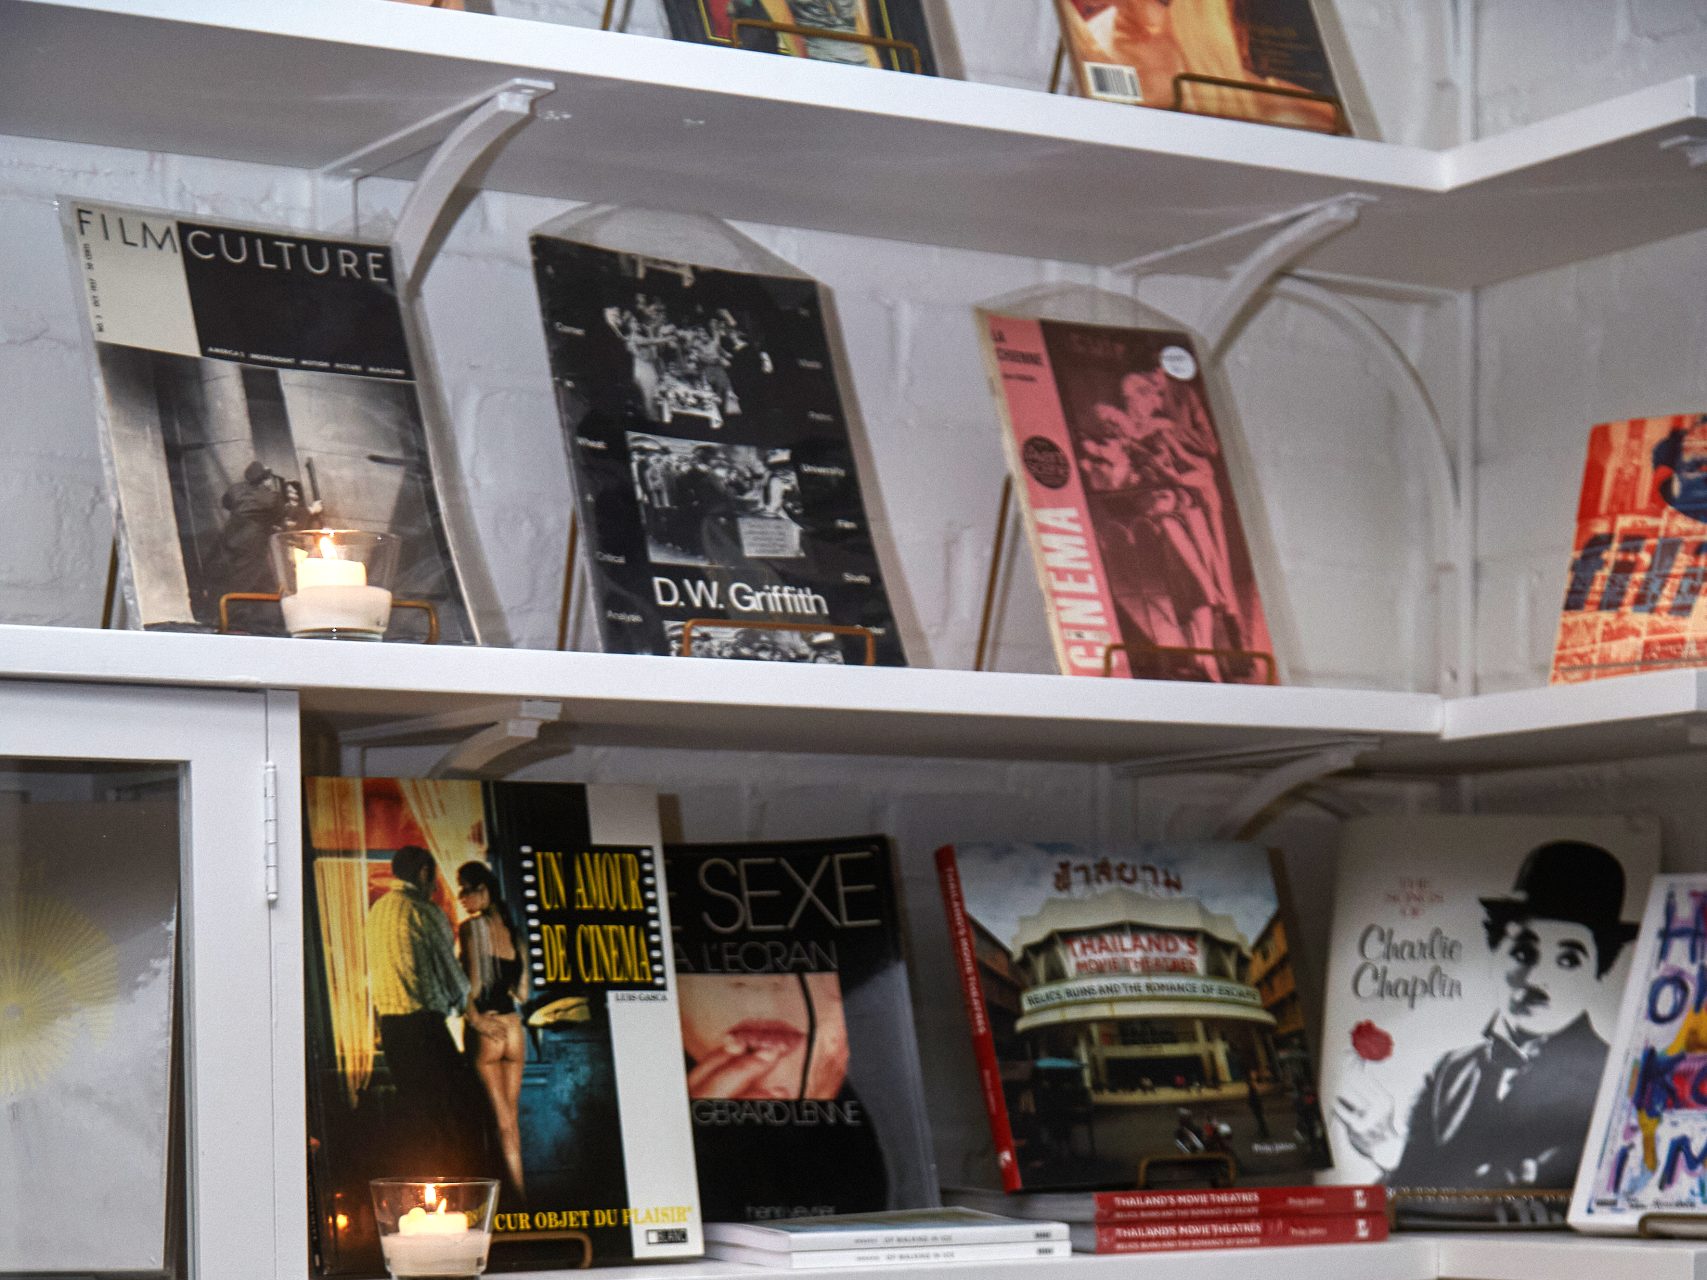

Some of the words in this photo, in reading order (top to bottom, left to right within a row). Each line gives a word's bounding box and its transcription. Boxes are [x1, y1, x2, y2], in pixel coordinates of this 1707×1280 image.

[76, 207, 178, 254] FILM
[186, 229, 391, 283] CULTURE
[729, 582, 830, 615] Griffith
[1035, 506, 1120, 674] CINEMA
[535, 850, 568, 910] UN
[573, 851, 644, 911] AMOUR
[698, 850, 883, 935] SEXE
[541, 922, 573, 982] DE
[576, 923, 654, 983] CINEMA
[1063, 933, 1199, 958] THAILAND'S
[1359, 923, 1463, 962] Charlie
[1352, 961, 1463, 1010] Chaplin
[534, 1210, 589, 1229] OBJET
[595, 1209, 618, 1226] DU
[1113, 1194, 1176, 1208] THAILAND'S
[1210, 1191, 1261, 1204] THEATRES
[1115, 1226, 1178, 1238] THAILAND'S
[1213, 1222, 1262, 1234] THEATRES
